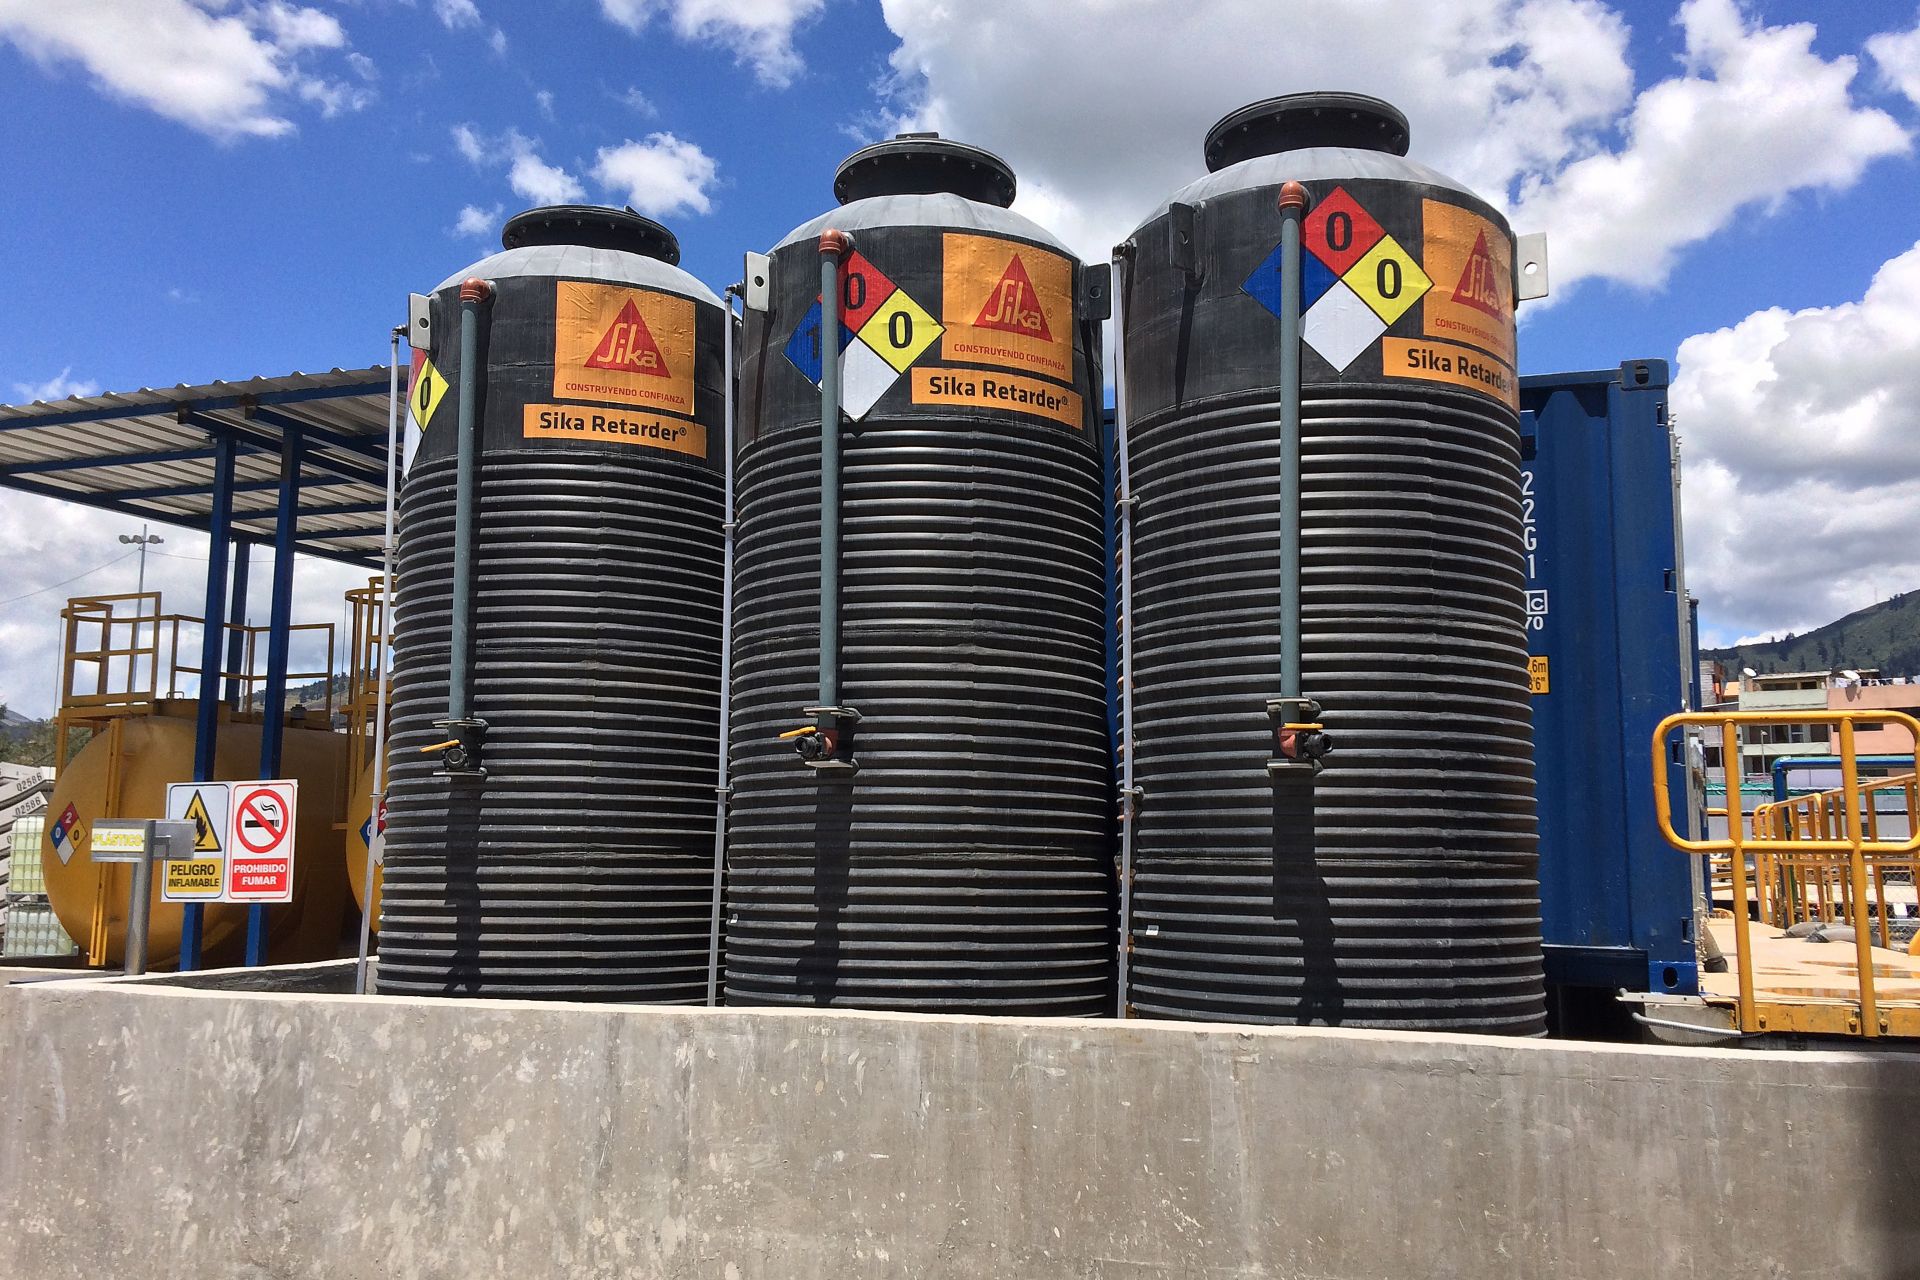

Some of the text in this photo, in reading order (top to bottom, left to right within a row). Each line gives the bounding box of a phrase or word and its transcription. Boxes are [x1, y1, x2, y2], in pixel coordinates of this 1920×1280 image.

[1326, 211, 1352, 251] 0
[843, 272, 866, 310] 0
[1376, 259, 1402, 299] 0
[985, 279, 1042, 331] Sika
[888, 311, 913, 349] 0
[596, 322, 658, 369] Sika
[806, 326, 820, 359] 1
[954, 343, 1066, 371] CONSTRUYENDO CONFIANZA
[1407, 348, 1451, 373] Sika
[419, 376, 431, 410] 0
[565, 382, 685, 405] CONSTRUYENDO CONFIANZA
[929, 376, 976, 397] Sika
[539, 411, 584, 431] Sika
[1521, 471, 1537, 579] 22G1
[1529, 659, 1546, 674] .6m
[64, 812, 73, 824] 2
[55, 826, 61, 839] 0
[73, 829, 80, 841] 0
[170, 864, 215, 876] PELIGRO
[234, 863, 286, 874] PROHIBIDO
[242, 876, 277, 885] FUMAR
[168, 878, 219, 888] INFLAMABLE
